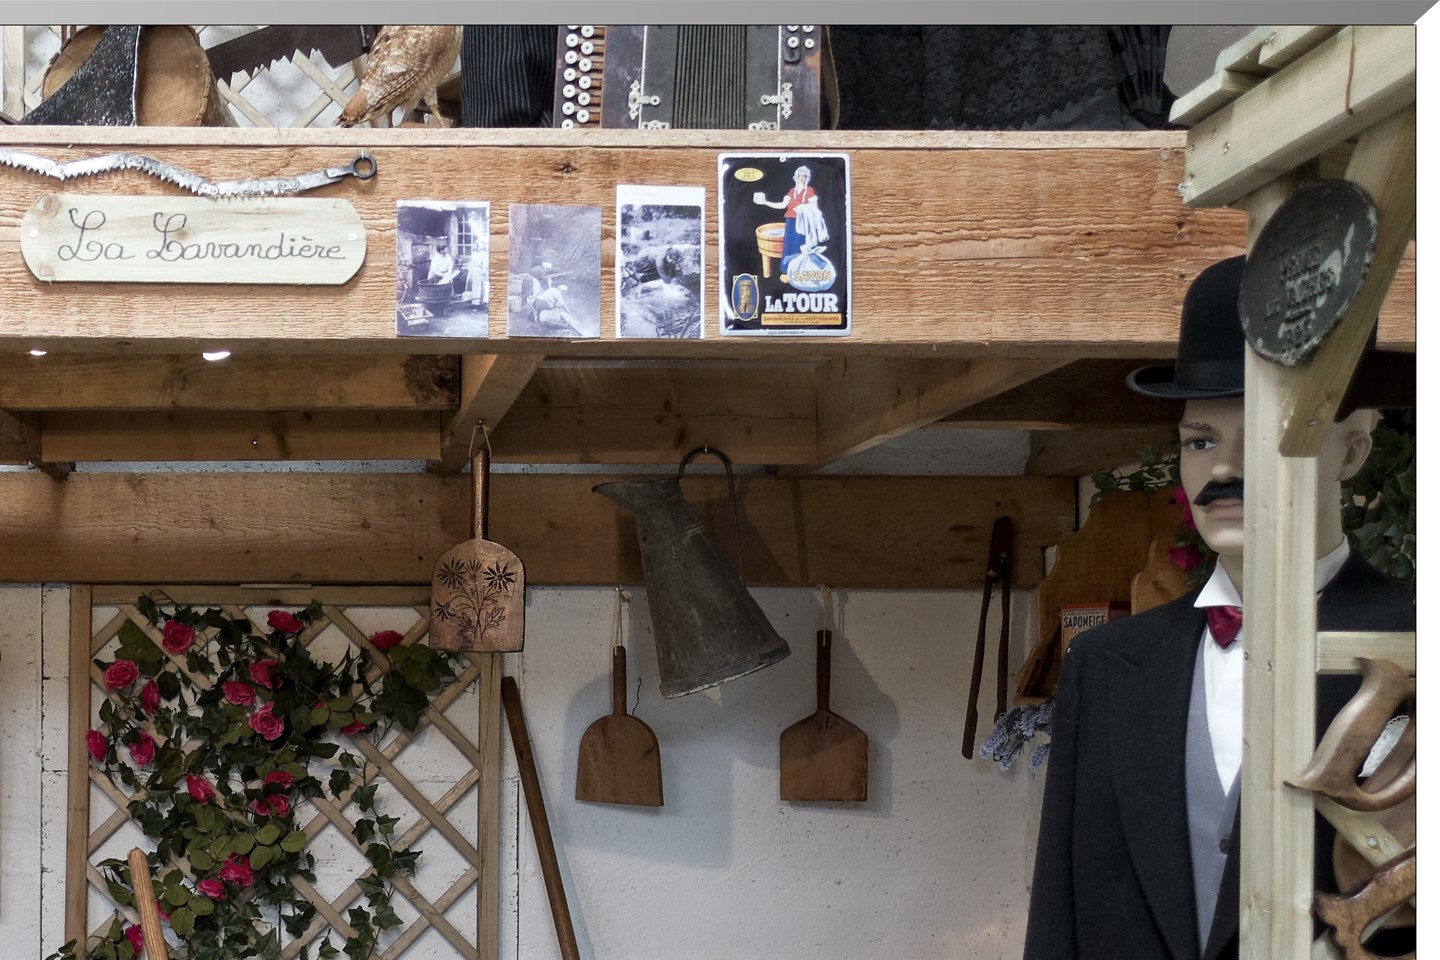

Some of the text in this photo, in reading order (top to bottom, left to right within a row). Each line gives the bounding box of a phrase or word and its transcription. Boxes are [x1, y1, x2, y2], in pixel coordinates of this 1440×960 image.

[58, 208, 346, 262] La Lavandière
[792, 270, 832, 281] SAVON
[783, 293, 838, 313] TOUR
